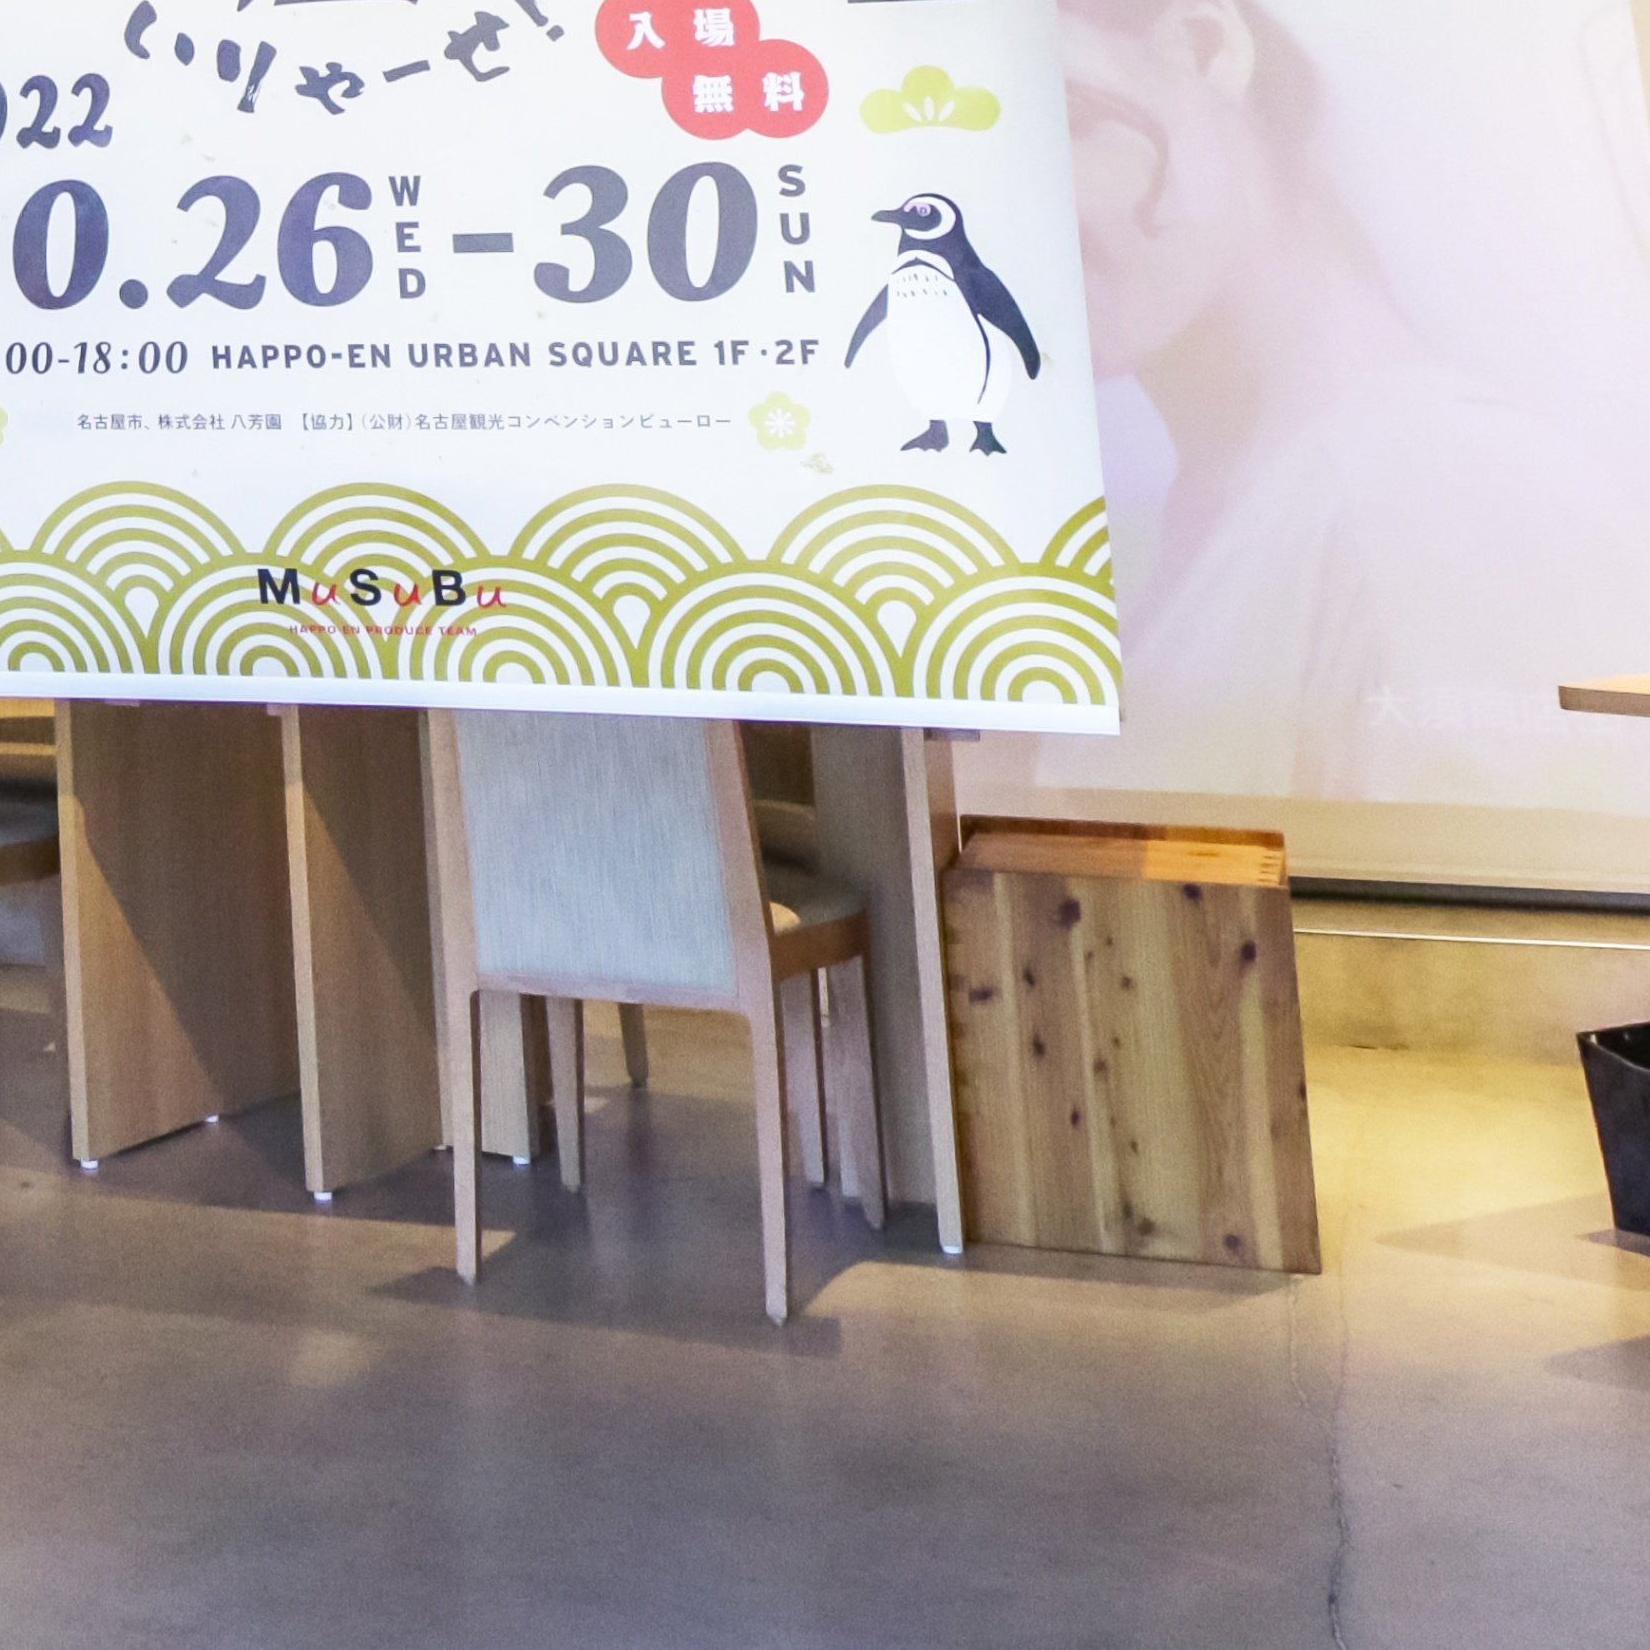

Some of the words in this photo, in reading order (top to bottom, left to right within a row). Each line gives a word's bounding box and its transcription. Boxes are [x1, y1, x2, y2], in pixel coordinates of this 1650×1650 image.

[627, 8, 735, 50] 入場
[692, 72, 805, 113] 無料
[388, 174, 427, 301] WED
[777, 164, 817, 295] SUN
[211, 343, 392, 370] HAPPO-EN
[407, 340, 532, 369] URBAN
[548, 340, 698, 368] SQUARE
[256, 567, 507, 609] MuSuBu
[289, 623, 337, 636] HAPPO
[343, 624, 360, 636] EN
[366, 625, 433, 637] PRODUCE
[439, 625, 478, 638] TEAM
